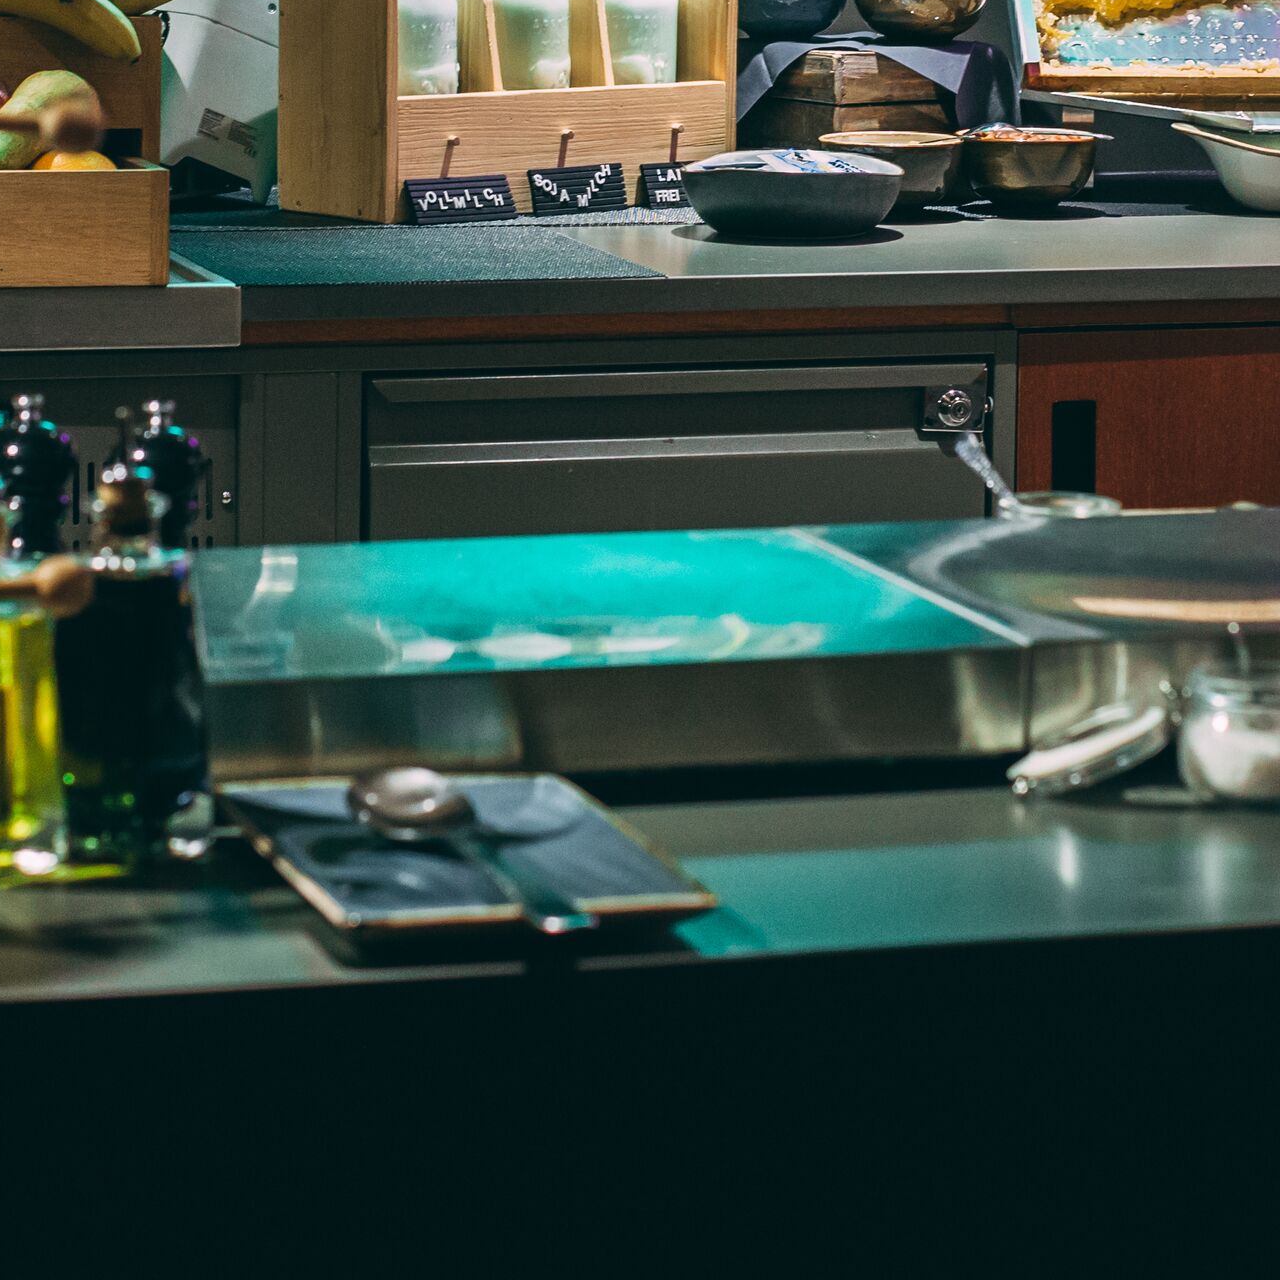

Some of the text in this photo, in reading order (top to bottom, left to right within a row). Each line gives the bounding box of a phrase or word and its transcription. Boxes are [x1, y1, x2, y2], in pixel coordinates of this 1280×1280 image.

[532, 164, 611, 208] SOJA MILCH
[655, 189, 680, 203] FREI
[418, 188, 505, 211] VOLLMILCH
